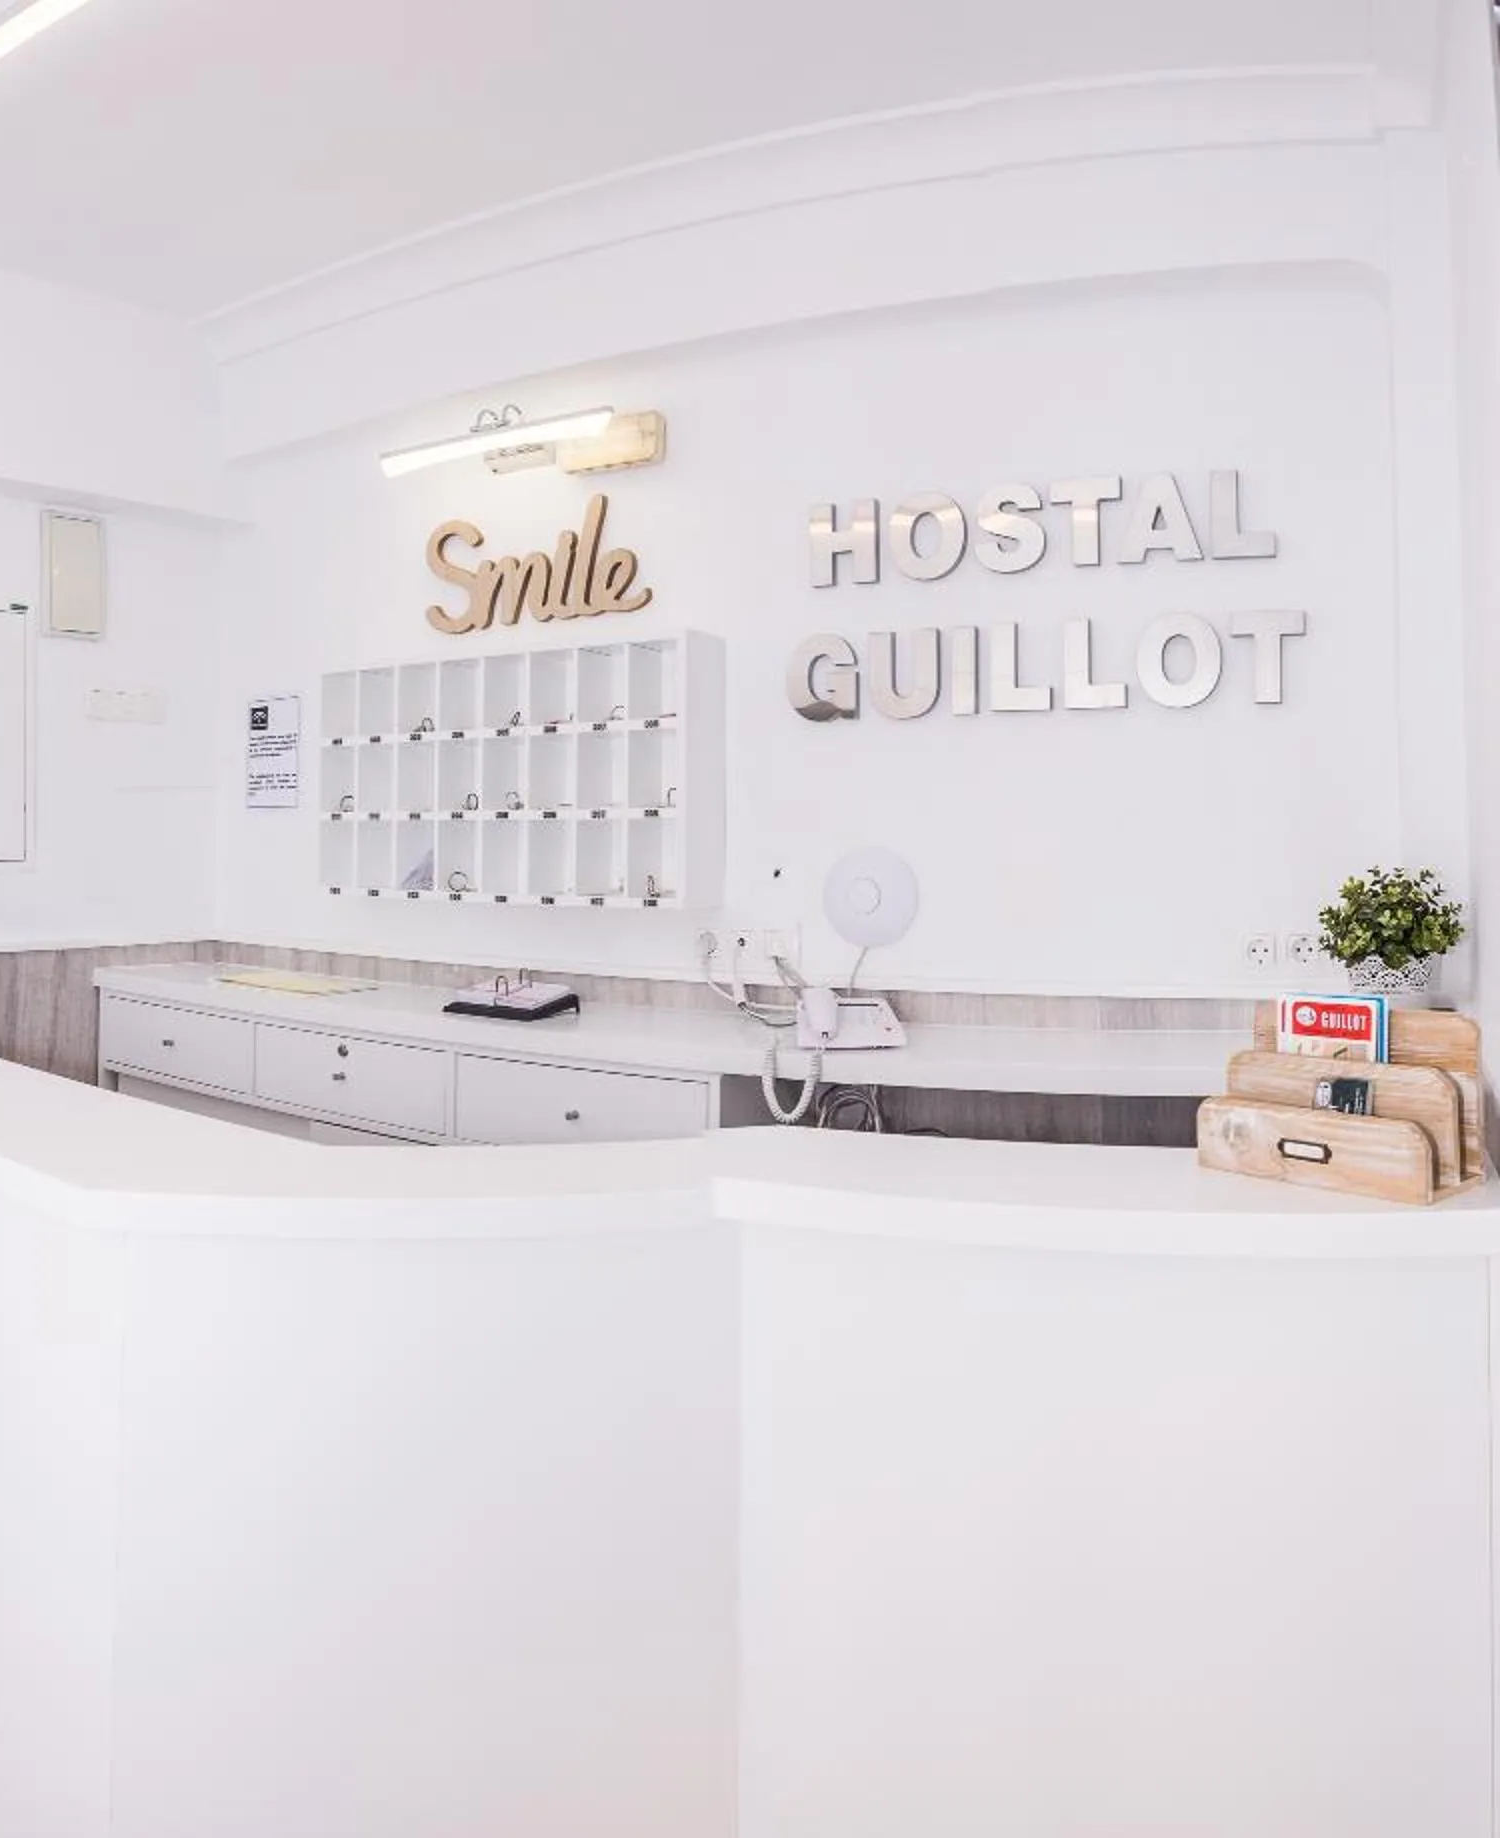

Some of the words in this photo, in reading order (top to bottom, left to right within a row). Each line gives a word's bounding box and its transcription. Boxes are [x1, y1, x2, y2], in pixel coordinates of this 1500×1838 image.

[425, 493, 653, 634] Smile
[807, 469, 1277, 588] HOSTAL
[785, 610, 1308, 722] GUILLOT
[1321, 1011, 1368, 1031] GUILLOT
